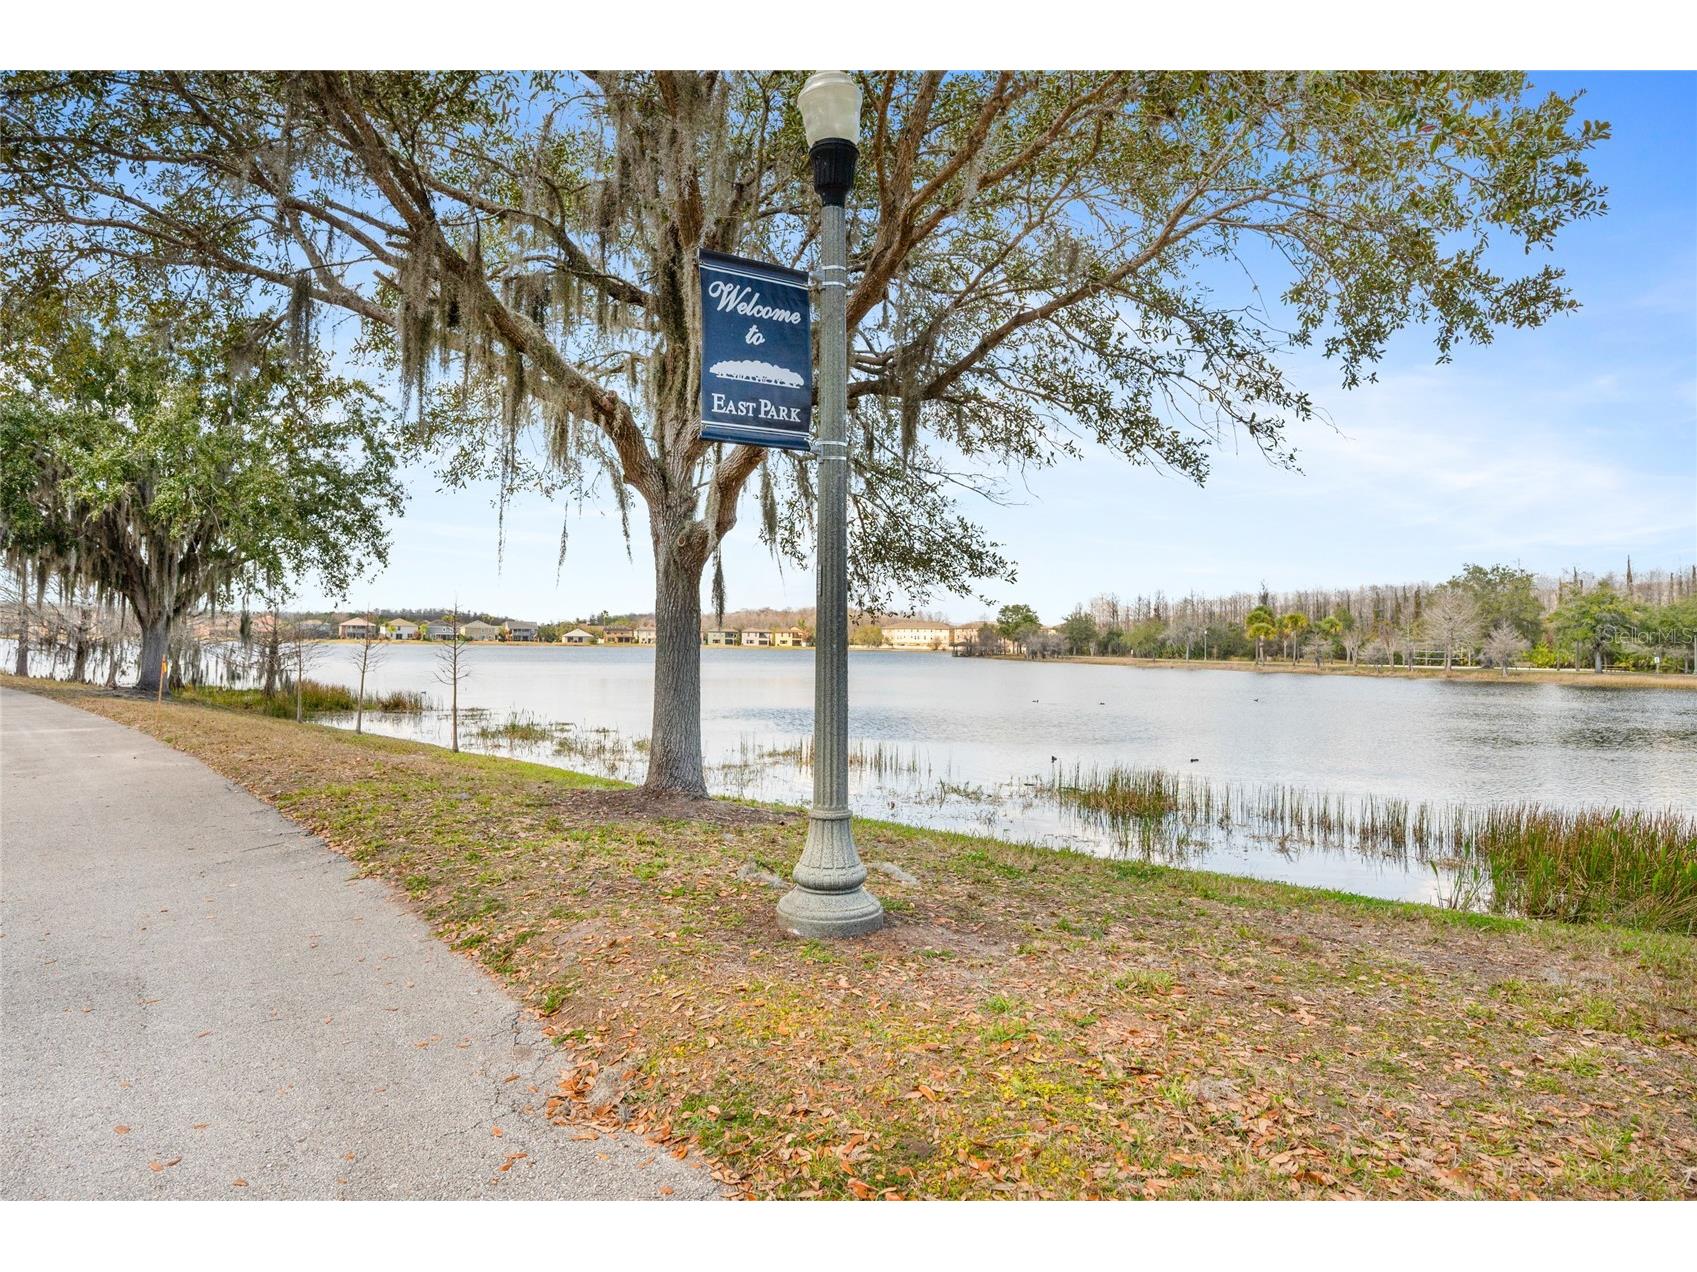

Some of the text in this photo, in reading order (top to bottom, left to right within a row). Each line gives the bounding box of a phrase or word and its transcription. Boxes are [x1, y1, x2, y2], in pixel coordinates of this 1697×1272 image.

[708, 280, 802, 324] Welcome
[745, 324, 766, 345] to
[711, 393, 801, 423] EAST PARK
